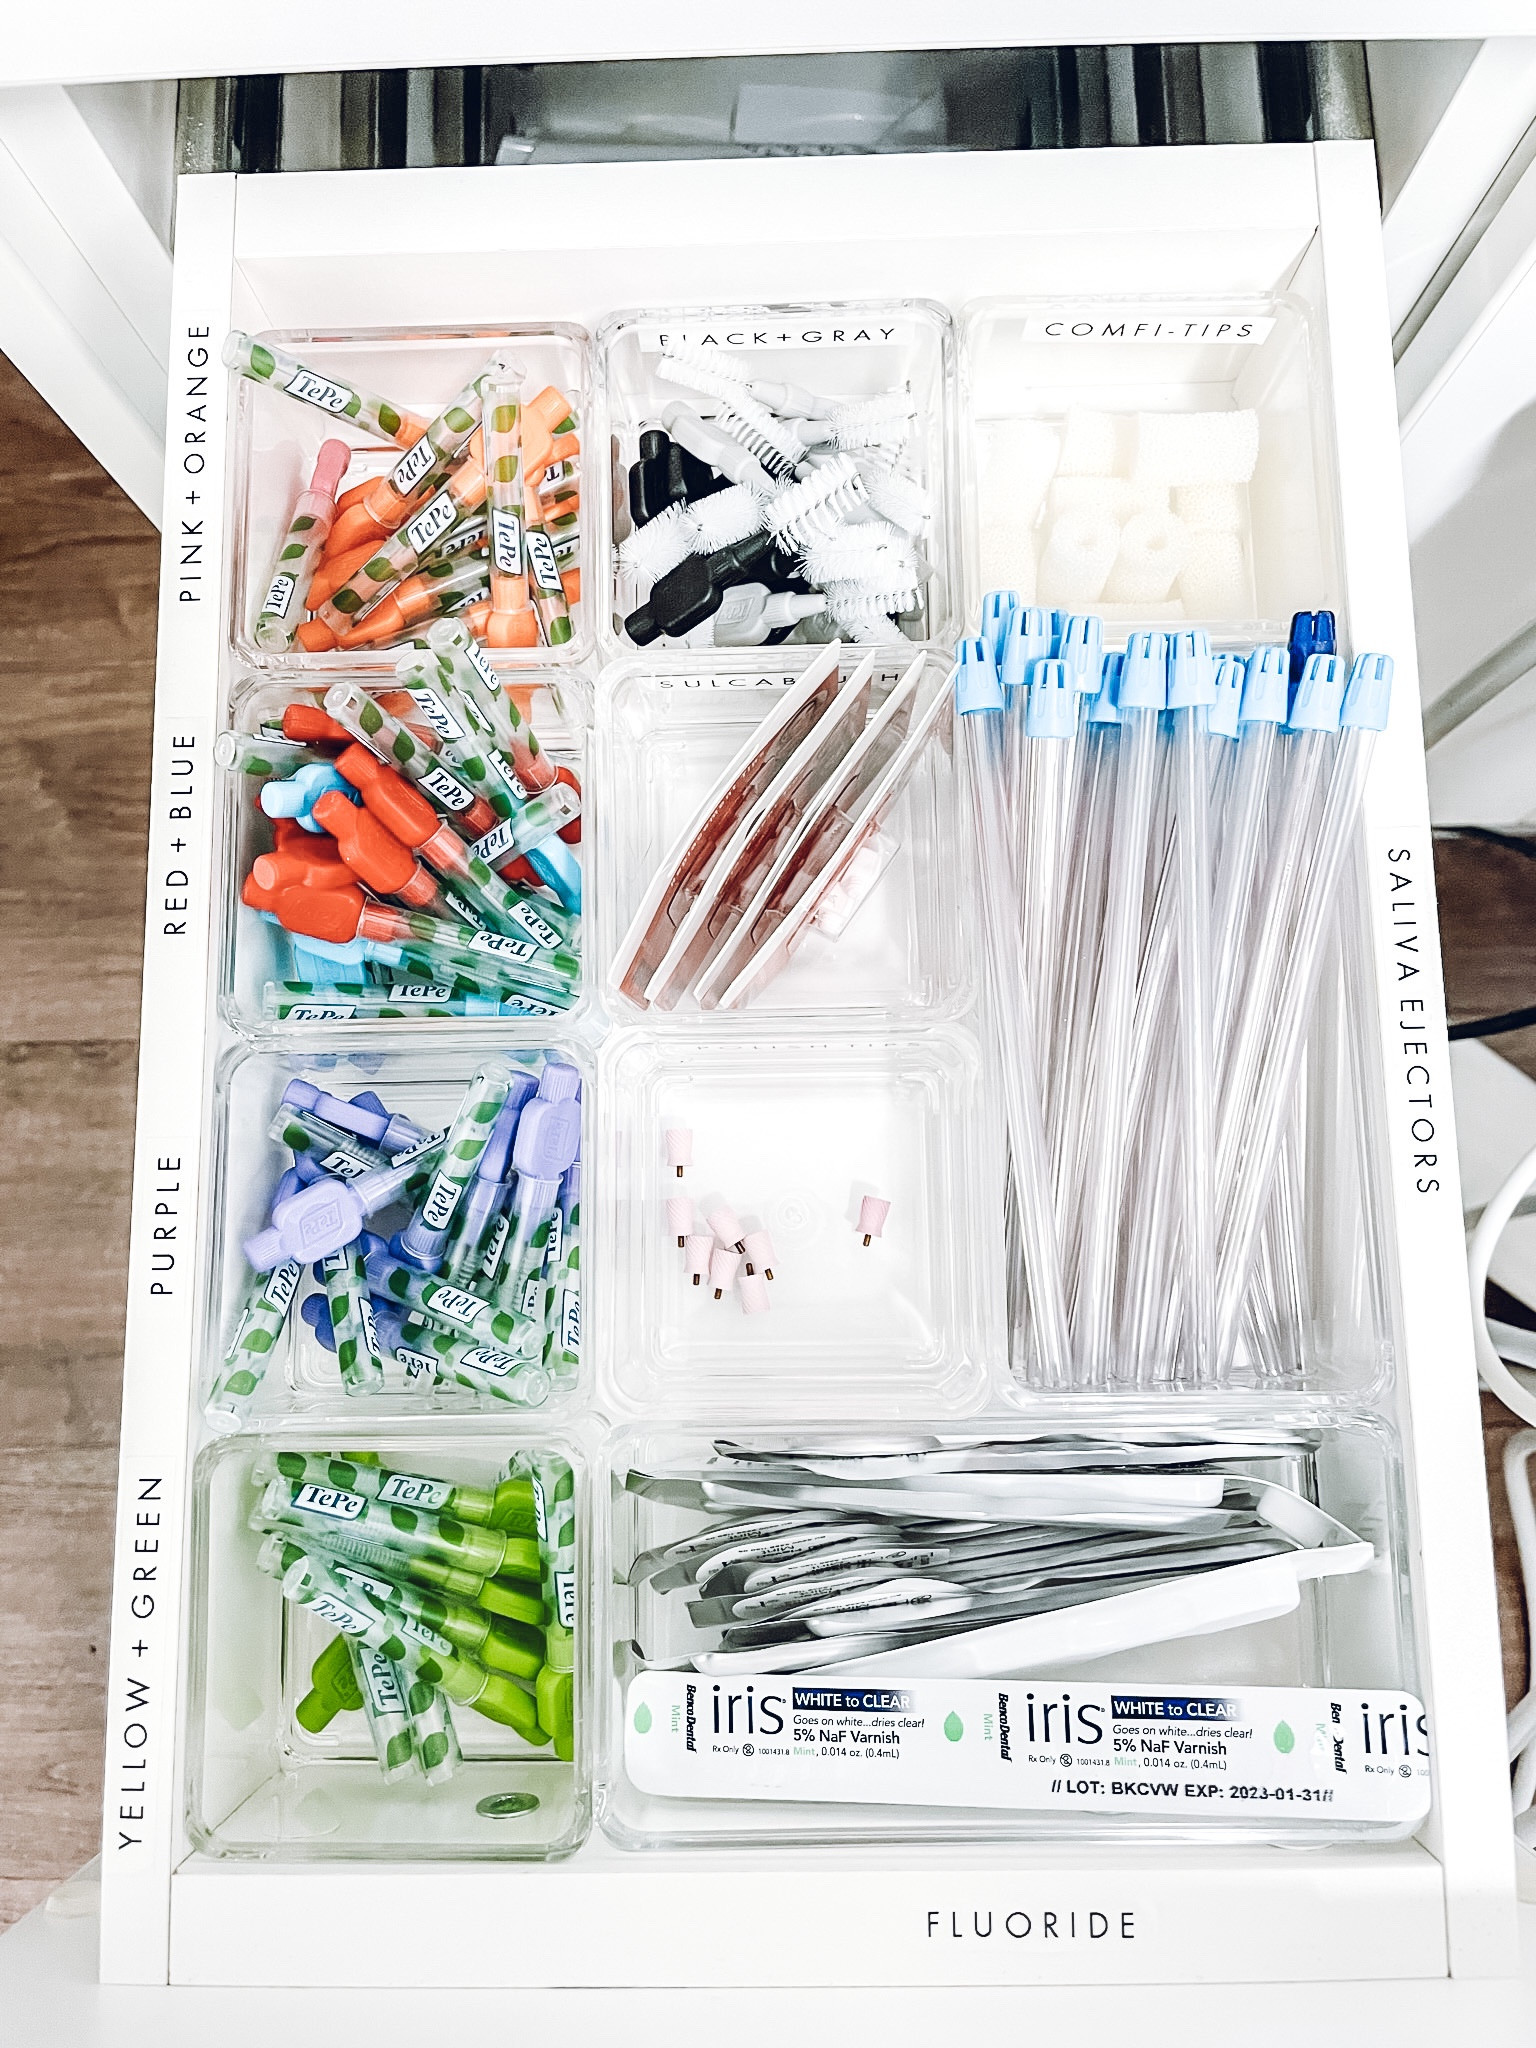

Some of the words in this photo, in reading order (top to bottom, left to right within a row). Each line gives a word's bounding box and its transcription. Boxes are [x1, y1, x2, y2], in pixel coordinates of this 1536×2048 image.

[1044, 322, 1254, 337] COMFI-TIPS
[183, 326, 210, 474] ORANGE
[297, 375, 344, 408] TePe
[397, 445, 432, 483] TePe
[411, 503, 452, 546] TePe
[498, 520, 515, 568] TePe
[533, 536, 557, 584] TePe
[179, 520, 204, 602] PINK
[265, 578, 289, 609] TePe
[659, 673, 900, 689] SULCABH
[414, 693, 450, 735] TePe
[169, 735, 195, 819] BLUE
[428, 771, 465, 807] TePe
[474, 826, 509, 859] TePe
[163, 869, 189, 935] RED
[1387, 848, 1421, 982] SALIVA
[520, 906, 553, 945] TePe
[480, 933, 527, 958] TePe
[1399, 999, 1440, 1193] EJECTORS
[427, 1183, 457, 1222] TePe
[150, 1157, 181, 1295] PURPLE
[270, 1262, 298, 1305] TePe
[437, 1289, 477, 1317] TePe
[306, 1486, 358, 1513] TePe
[391, 1478, 442, 1504] TePe
[131, 1478, 163, 1619] GREEN
[311, 1600, 357, 1630] TePe
[371, 1653, 400, 1706] TePe
[712, 1684, 785, 1735] iris
[794, 1692, 843, 1708] WHITE
[845, 1694, 861, 1708] to
[862, 1694, 911, 1709] CLEAR
[1113, 1700, 1165, 1716] WHITE
[1167, 1702, 1184, 1717] to
[1186, 1703, 1237, 1718] CLEAR
[671, 1704, 681, 1734] Mint
[793, 1714, 819, 1726] Goes
[821, 1717, 834, 1727] on
[897, 1717, 926, 1729] clear!
[983, 1713, 994, 1741] Mint
[1026, 1693, 1104, 1745] iris
[1112, 1724, 1140, 1736] Goes
[1142, 1727, 1156, 1737] on
[1224, 1728, 1253, 1740] clear!
[712, 1744, 722, 1753] Rx
[722, 1745, 740, 1755] Only
[793, 1729, 816, 1743] 5%
[819, 1730, 847, 1744] NaF
[850, 1731, 901, 1745] Varnish
[821, 1747, 847, 1757] 0.014
[849, 1749, 863, 1758] oz.
[865, 1747, 901, 1760] (0.4mL)
[1113, 1738, 1137, 1753] 5%
[1141, 1739, 1170, 1754] NaF
[1173, 1740, 1228, 1755] Varnish
[118, 1677, 151, 1850] YELLOW
[1143, 1757, 1170, 1768] 0.014
[1173, 1759, 1188, 1769] oz.
[1190, 1758, 1228, 1771] (0.4mL)
[1066, 1780, 1106, 1795] LOT:
[1111, 1782, 1179, 1797] BKCVW
[1184, 1784, 1224, 1799] EXP:
[927, 1911, 1135, 1939] FLUORIDE
